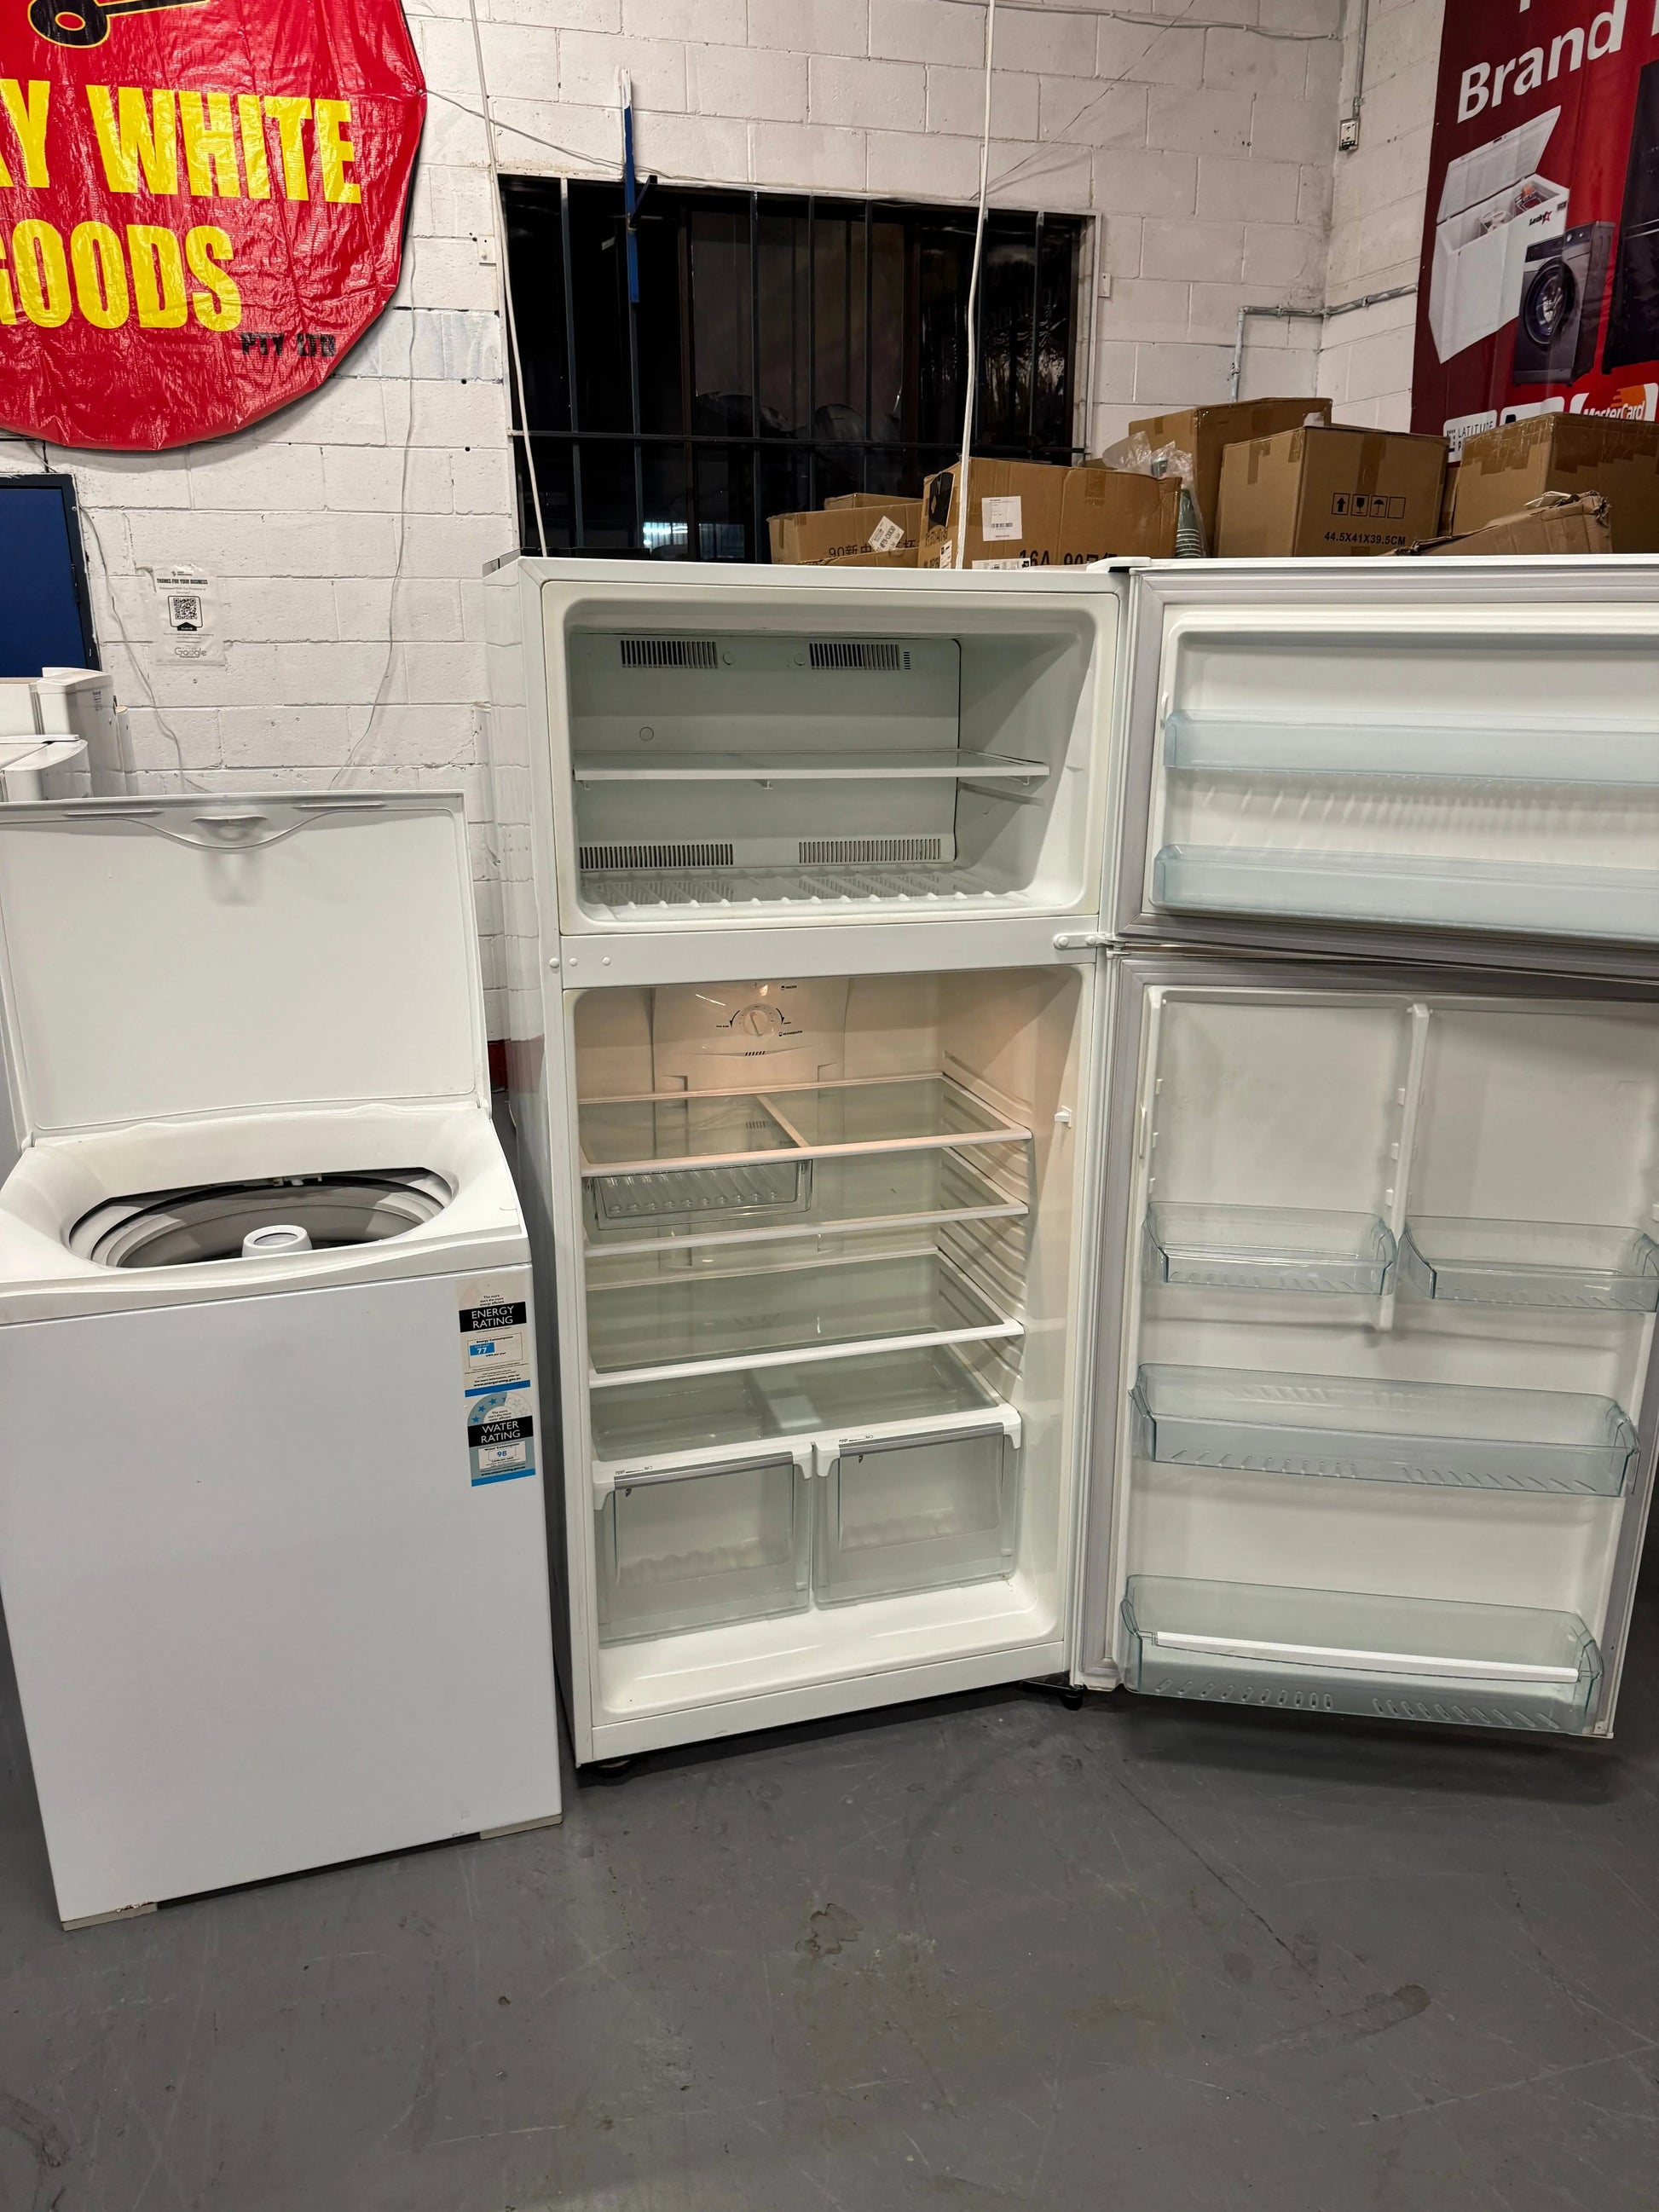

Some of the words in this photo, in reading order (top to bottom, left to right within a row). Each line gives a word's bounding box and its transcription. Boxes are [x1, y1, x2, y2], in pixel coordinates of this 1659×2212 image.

[1457, 0, 1627, 124] Brand
[0, 78, 50, 188] Y
[87, 85, 361, 204] WHITE
[240, 332, 285, 356] PTY
[297, 332, 336, 357] LTD
[1323, 531, 1406, 546] 44.5X41X39.5CM
[175, 647, 207, 658] Google
[471, 1305, 514, 1320] ENERGY
[472, 1315, 513, 1329] RATING
[482, 1420, 519, 1434] WATER
[481, 1429, 521, 1444] RATING
